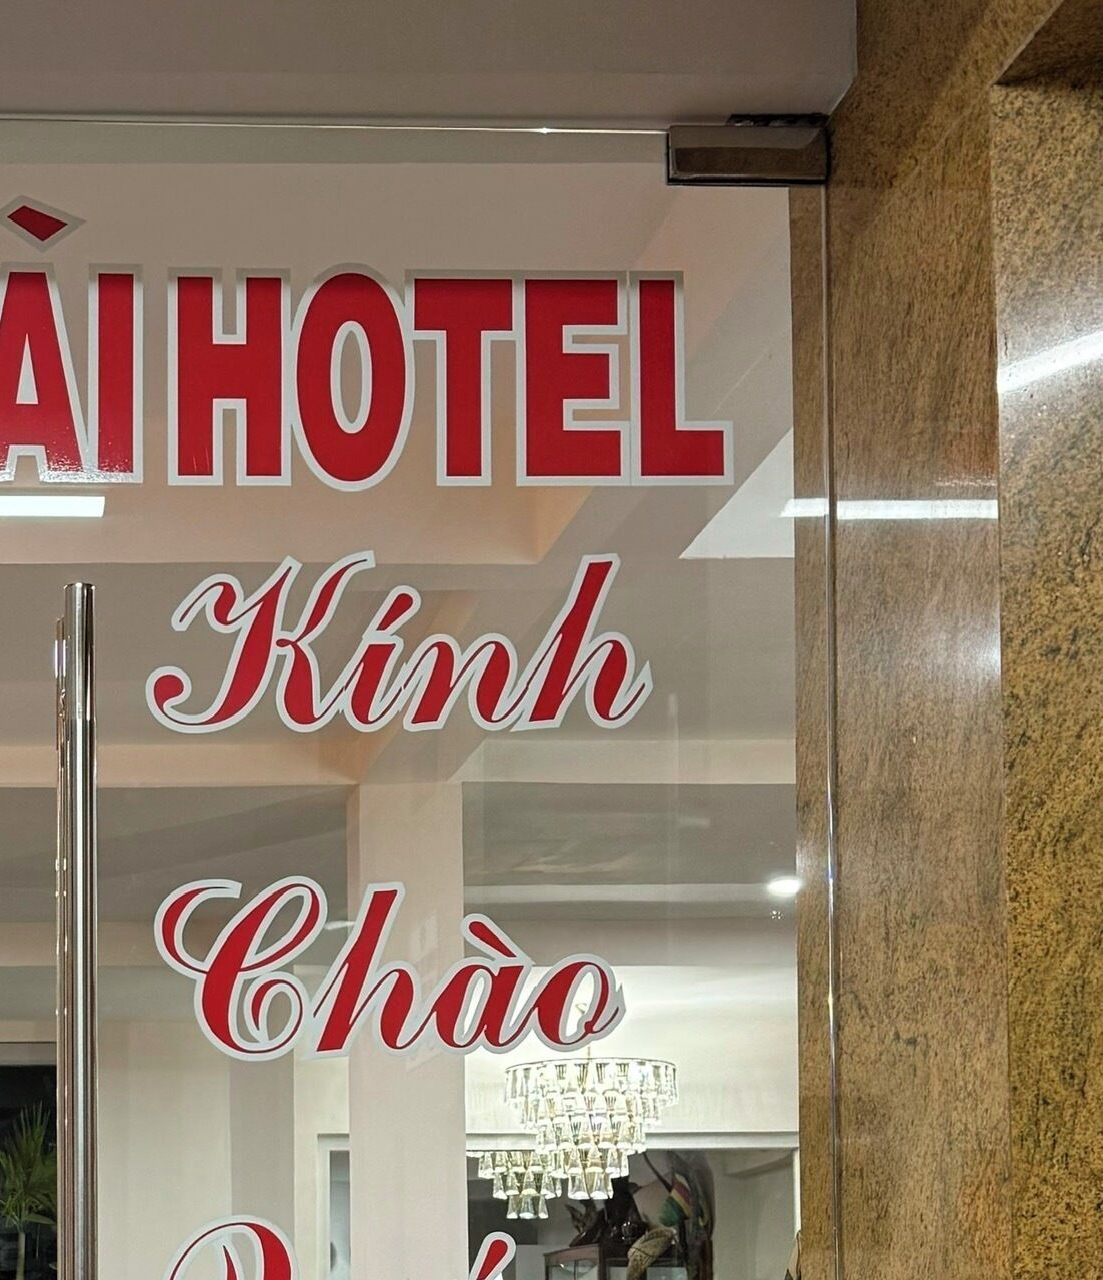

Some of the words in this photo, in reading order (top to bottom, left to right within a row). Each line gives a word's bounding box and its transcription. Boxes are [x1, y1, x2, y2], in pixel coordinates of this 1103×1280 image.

[167, 263, 735, 493] HOTEL
[146, 550, 653, 733] Kính
[154, 875, 627, 1061] Chào
